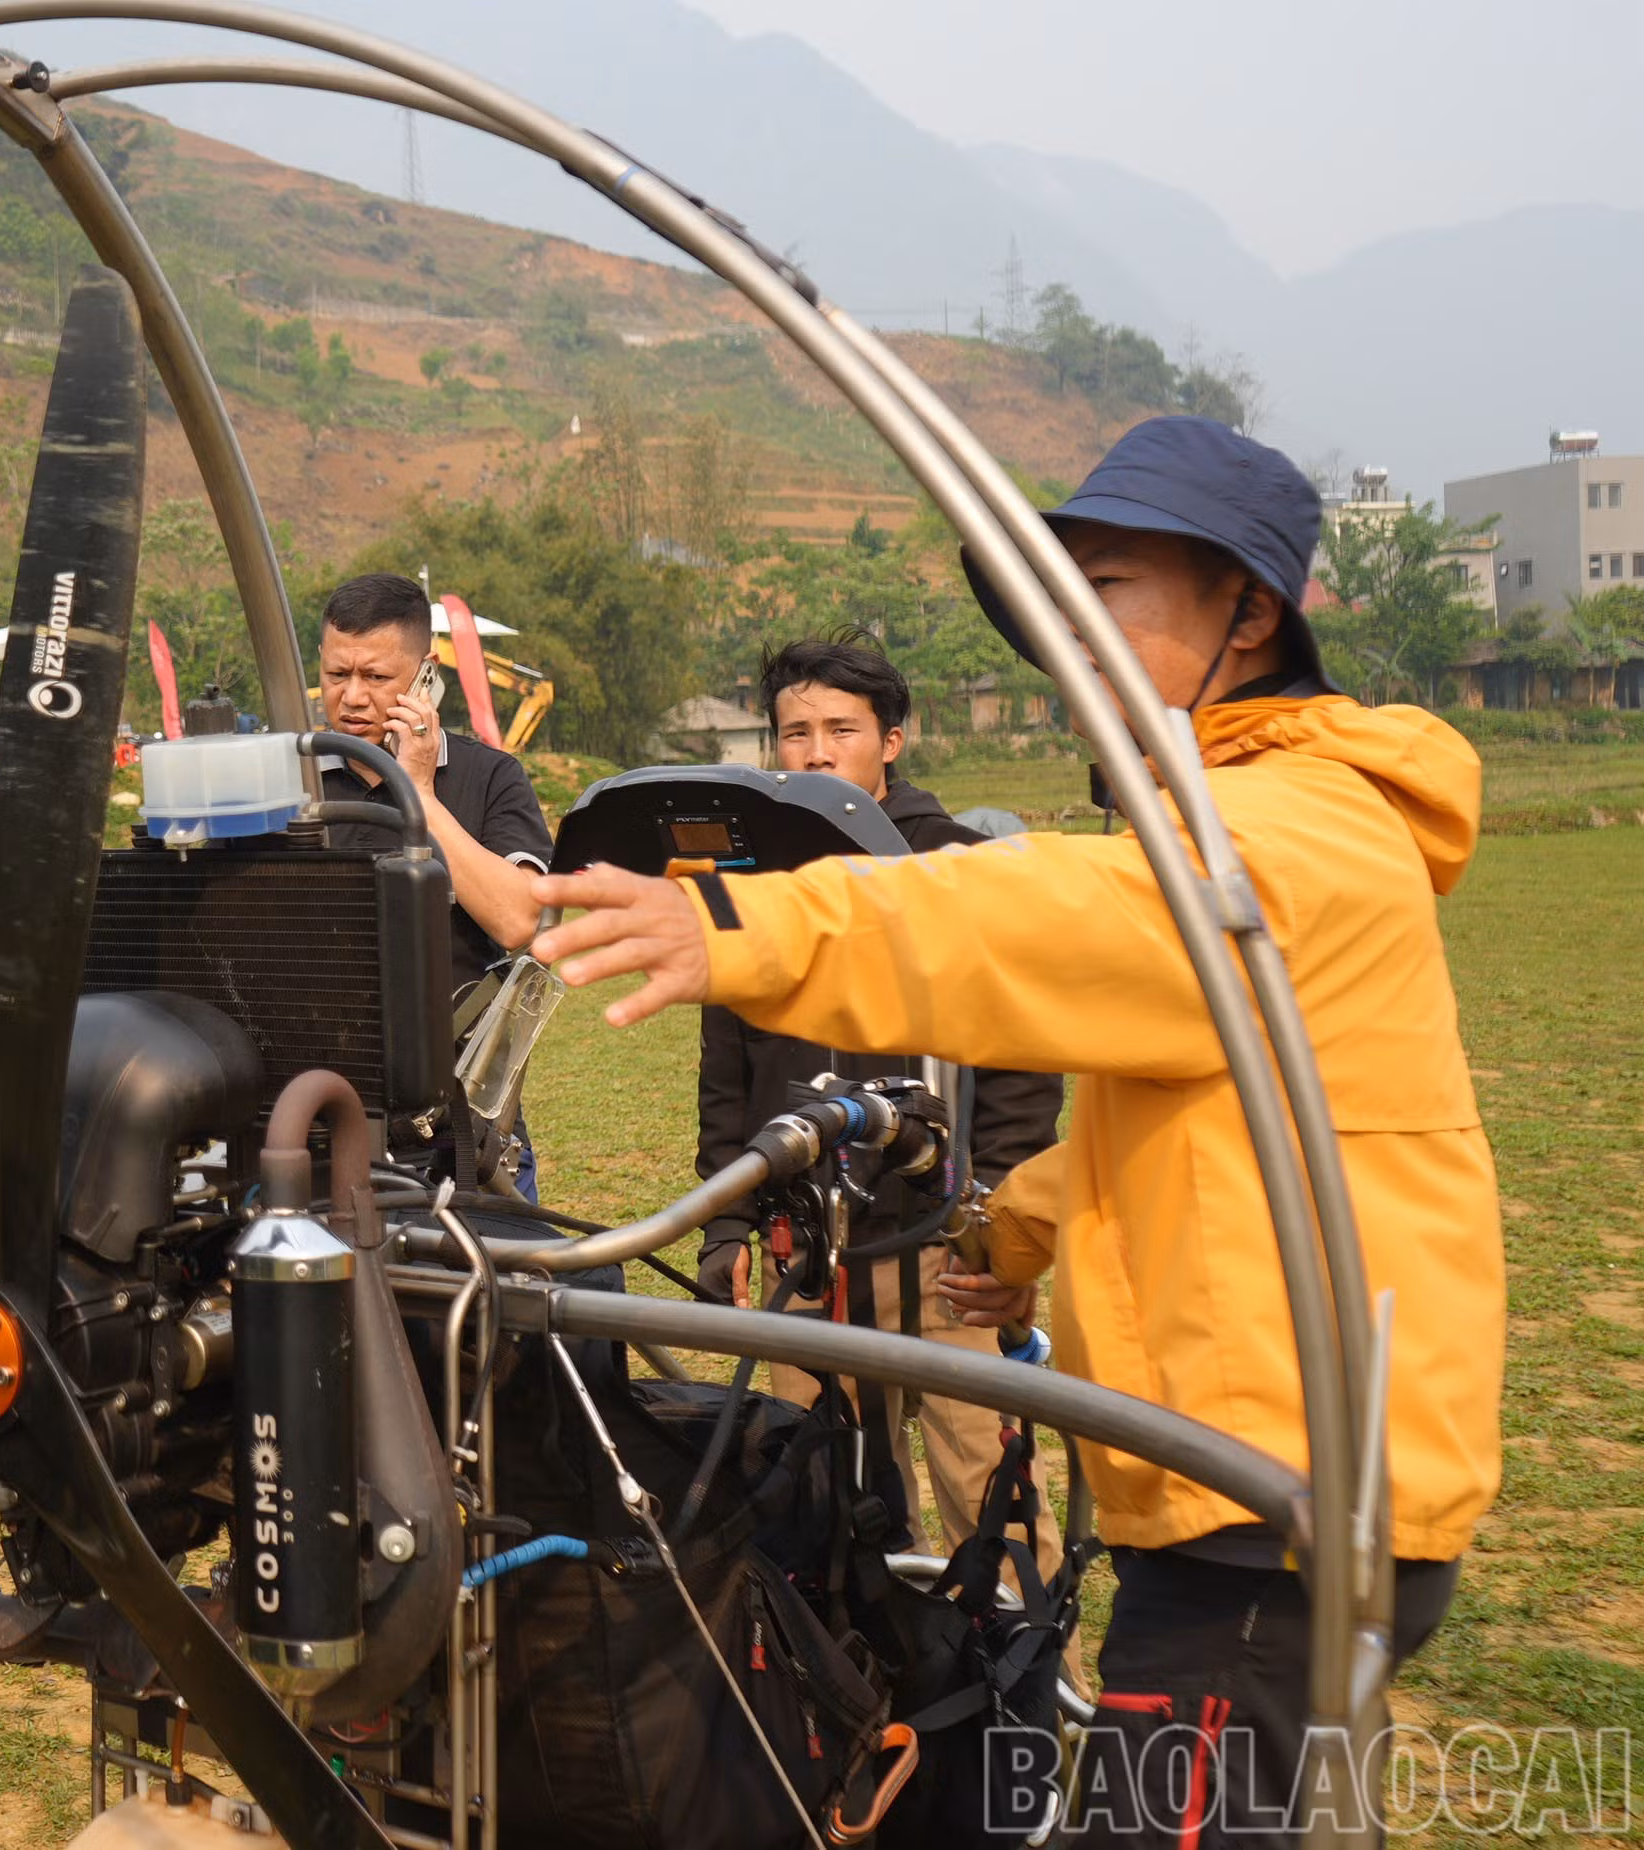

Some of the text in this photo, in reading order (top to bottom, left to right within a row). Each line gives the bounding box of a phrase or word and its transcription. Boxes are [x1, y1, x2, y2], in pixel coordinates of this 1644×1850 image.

[31, 624, 48, 674] MOTORS
[249, 1413, 282, 1613] COSMOS
[282, 1488, 295, 1544] 300
